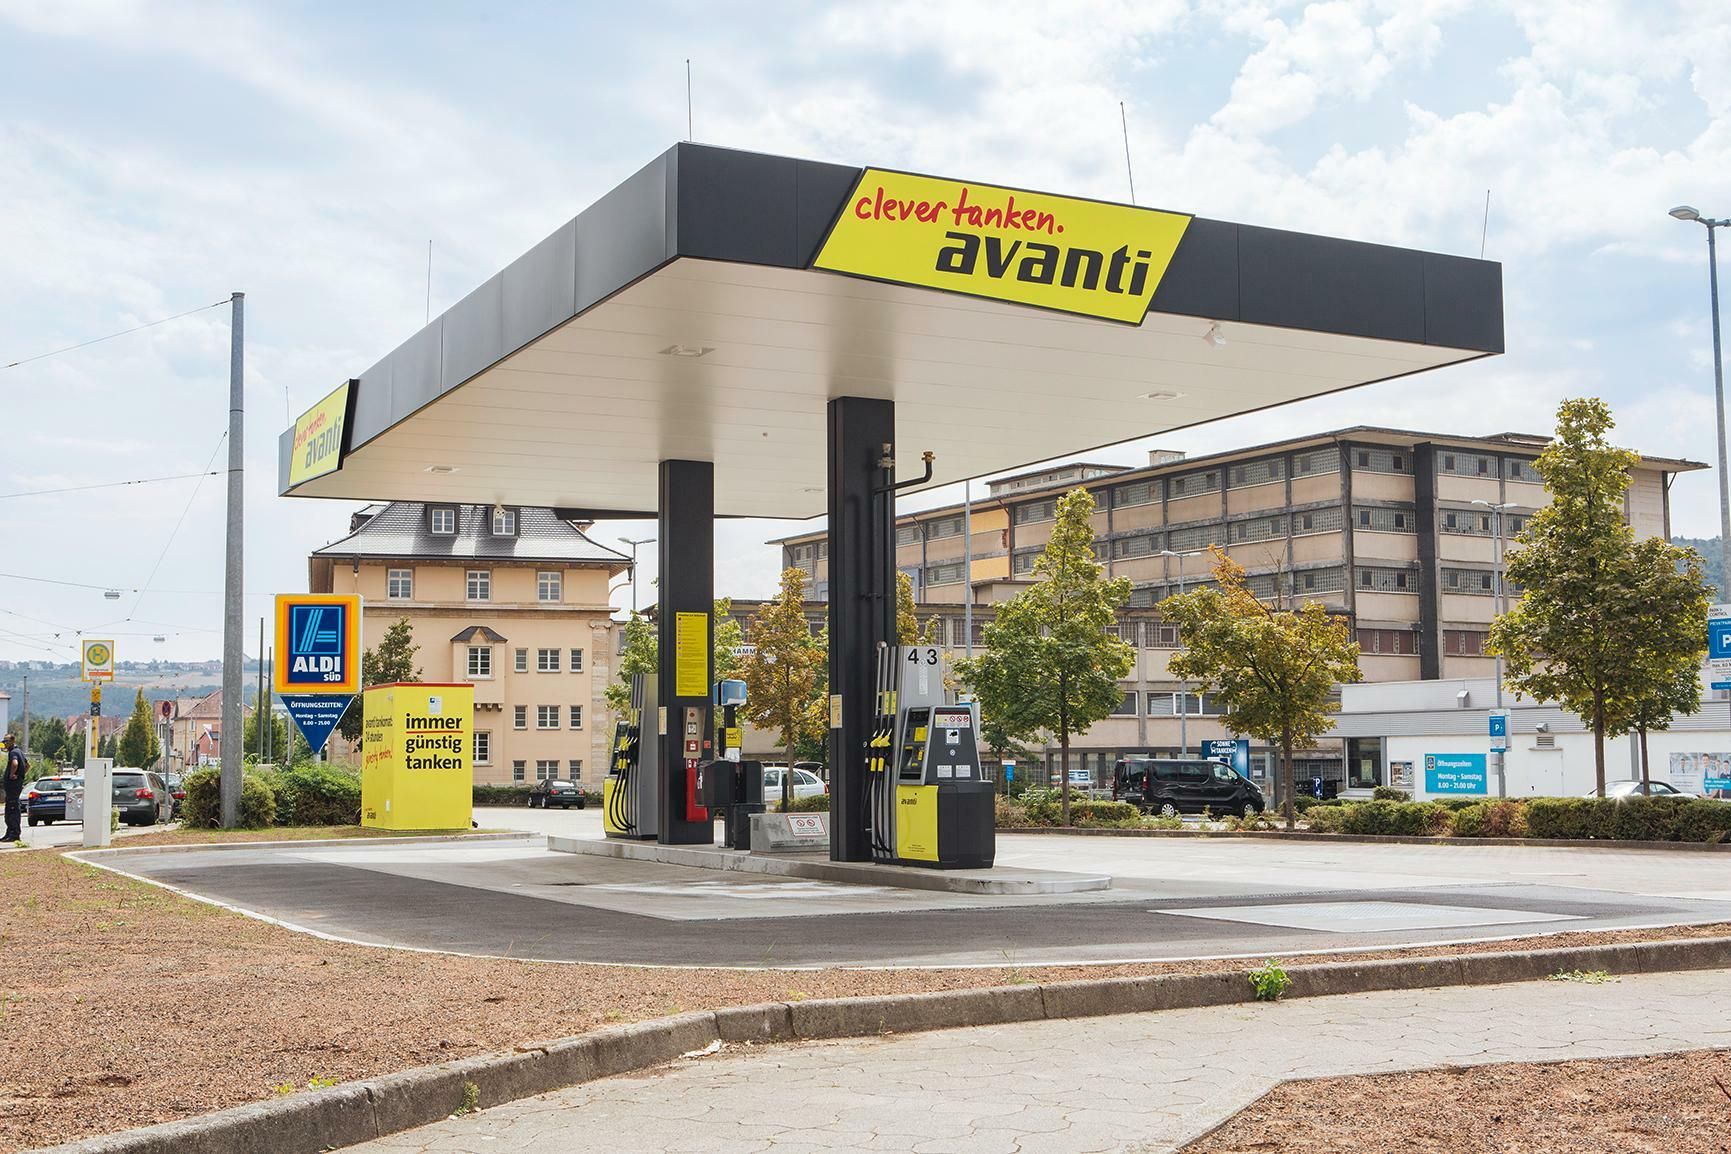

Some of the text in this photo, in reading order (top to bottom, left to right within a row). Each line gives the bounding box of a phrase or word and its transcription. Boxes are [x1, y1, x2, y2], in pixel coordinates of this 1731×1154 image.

[855, 186, 1065, 235] clever tanken.
[935, 231, 1153, 296] avanti
[305, 416, 341, 468] avanti
[292, 656, 341, 673] ALDI
[908, 648, 938, 665] 4 3
[323, 672, 341, 682] SÜD
[405, 712, 463, 729] immer
[405, 735, 462, 753] günstig
[405, 754, 462, 770] tanken
[1437, 759, 1472, 768] Öffnungszeiten
[1437, 773, 1456, 781] Montag
[1460, 773, 1482, 782] Samstag
